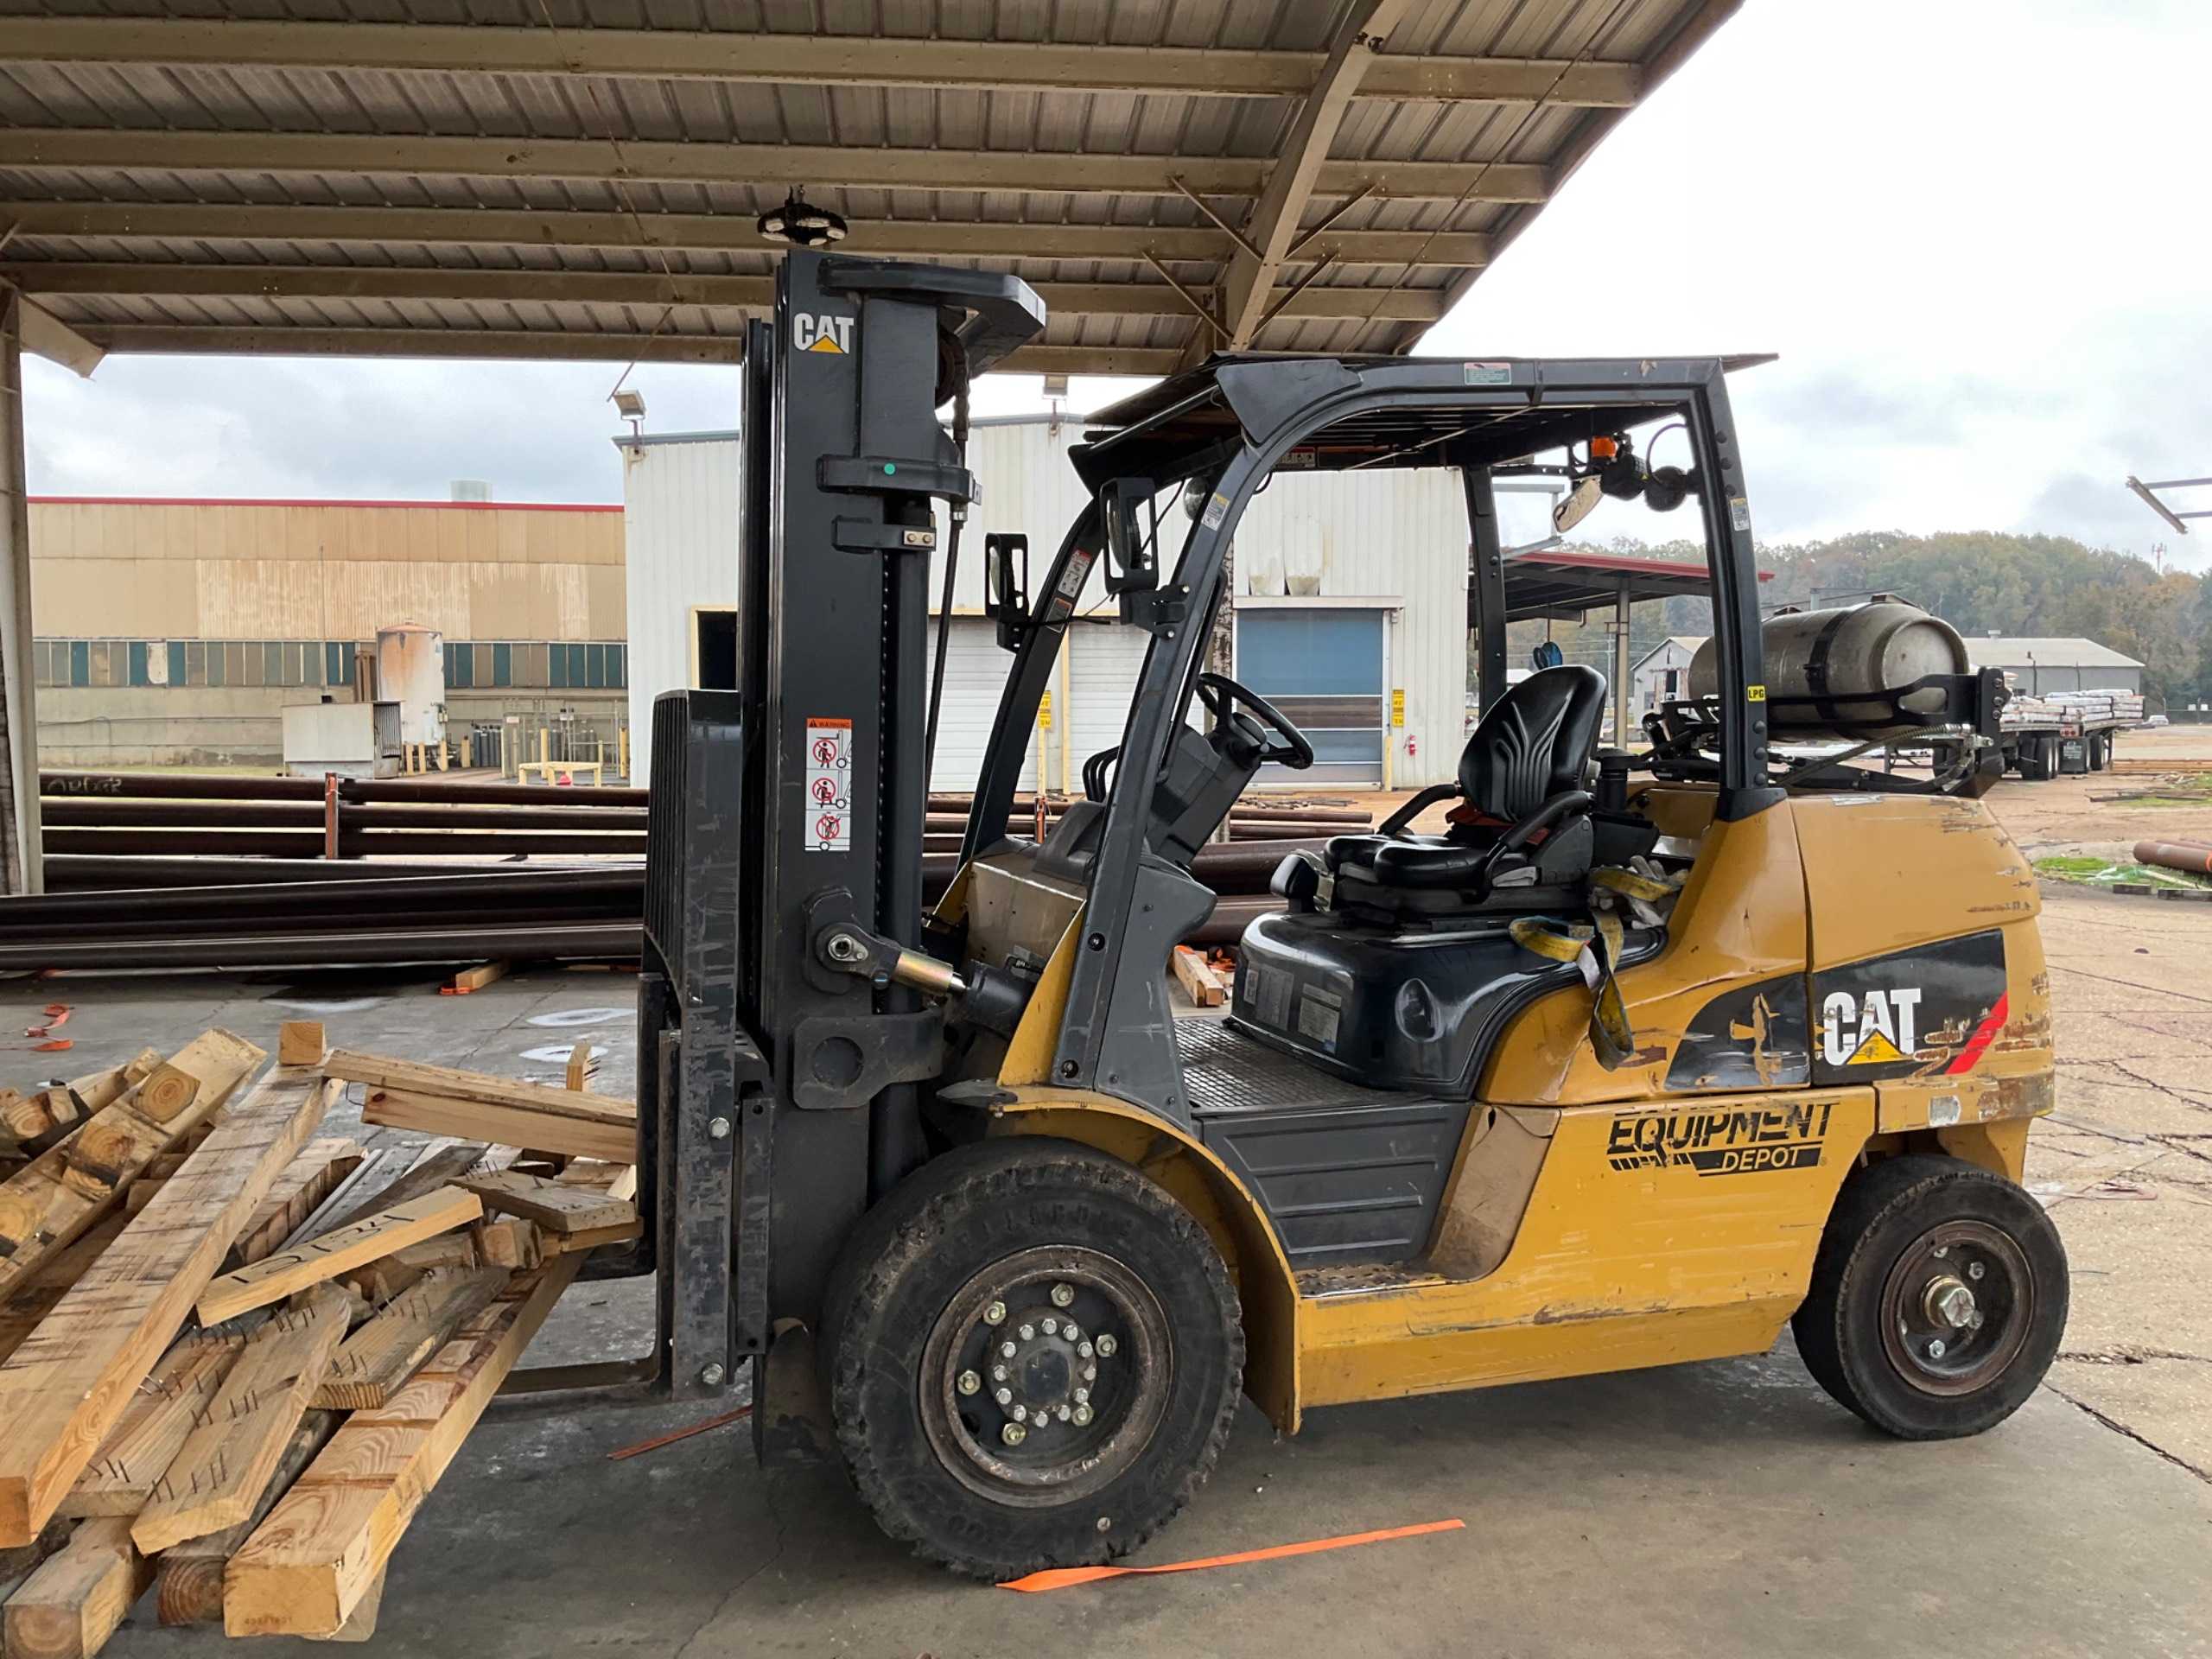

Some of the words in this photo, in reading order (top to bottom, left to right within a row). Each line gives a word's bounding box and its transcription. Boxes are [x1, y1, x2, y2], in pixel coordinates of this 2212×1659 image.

[794, 313, 854, 354] CAT
[1748, 689, 1764, 699] LPG
[1823, 988, 1922, 1066] CAT
[1606, 1101, 1840, 1166] EQUIPMENT
[1721, 1146, 1802, 1172] DEPOT
